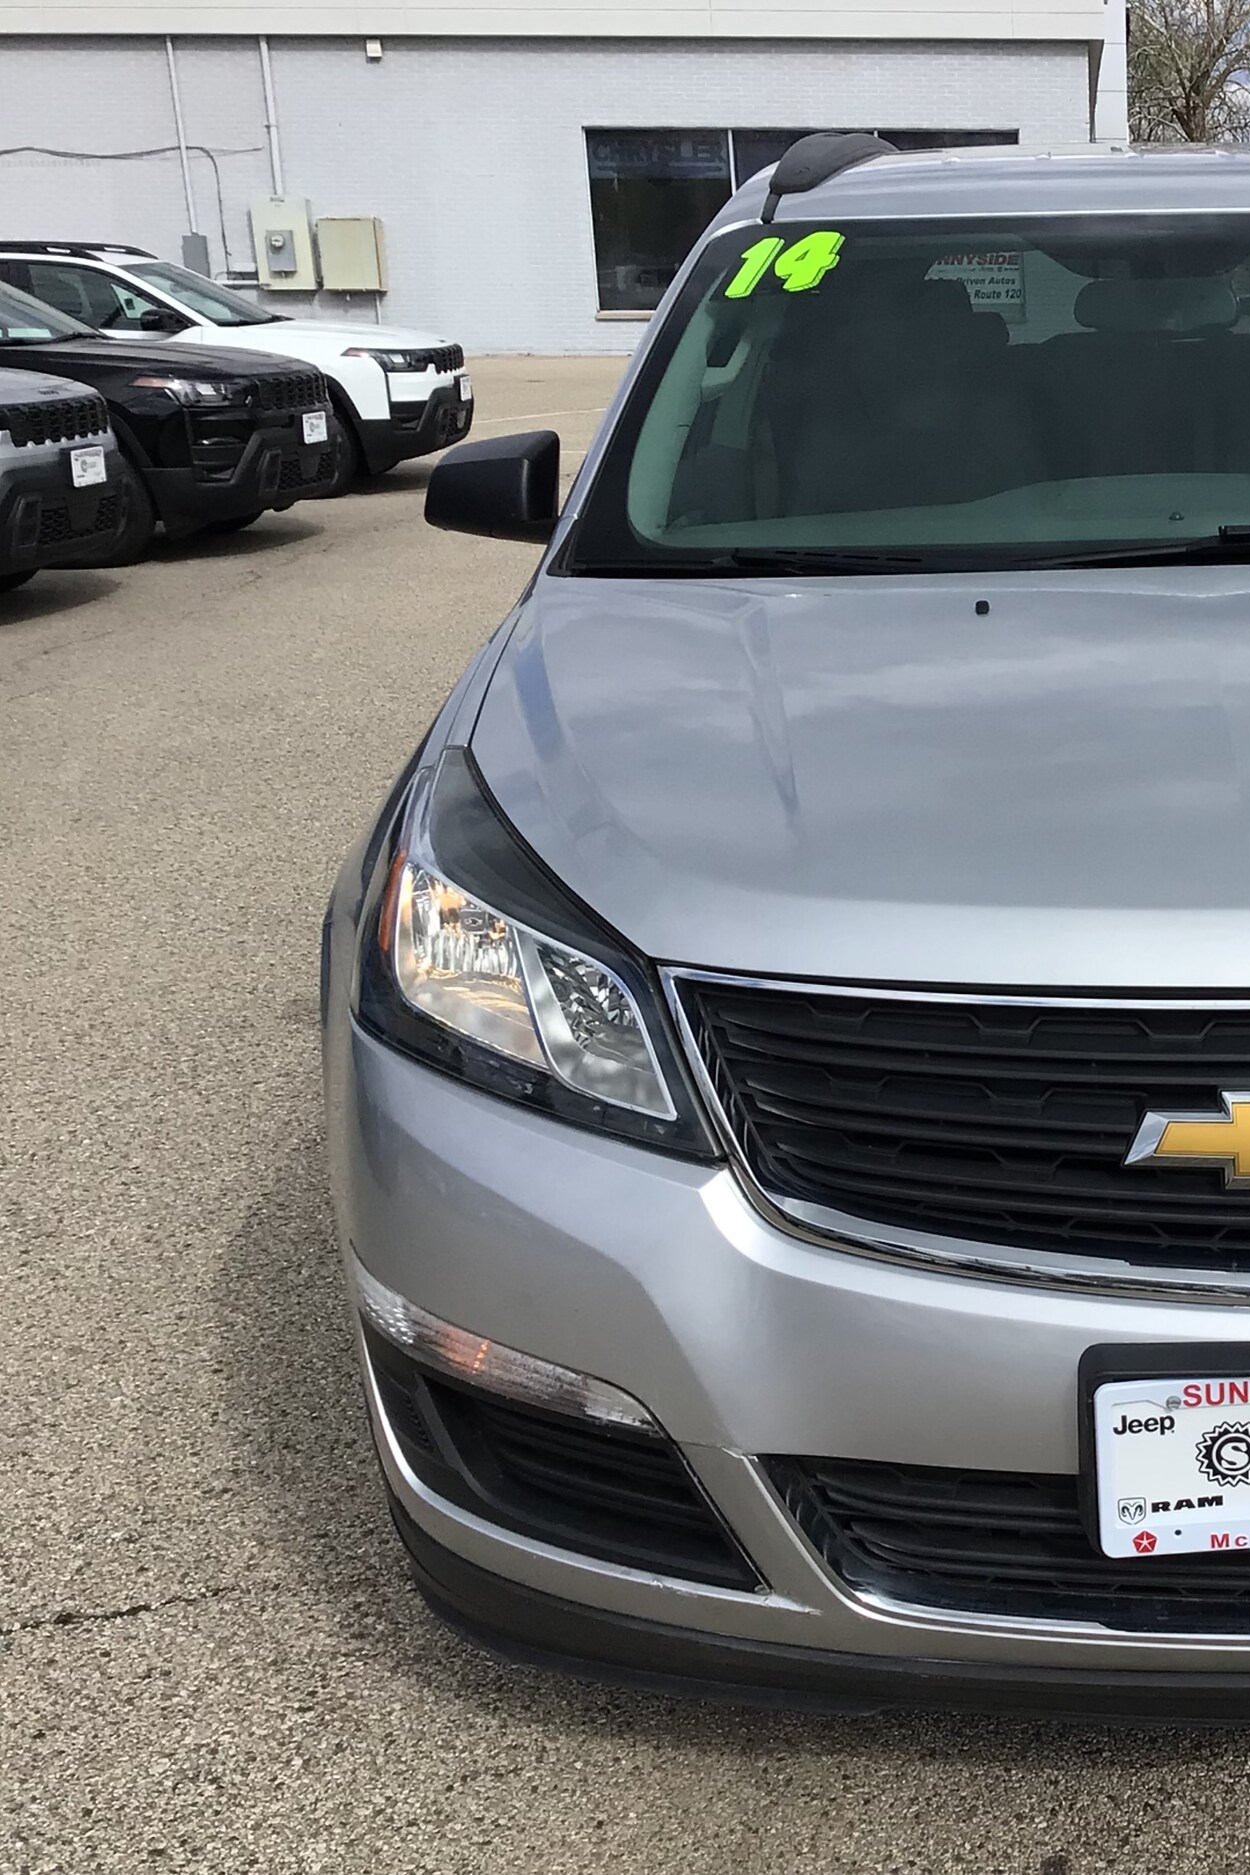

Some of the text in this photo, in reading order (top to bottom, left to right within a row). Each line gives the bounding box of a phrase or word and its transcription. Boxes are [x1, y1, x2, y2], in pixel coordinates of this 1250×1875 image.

[725, 231, 846, 298] 14
[988, 277, 1016, 285] Autos
[973, 288, 1022, 299] Route 120
[1113, 1415, 1175, 1435] Jeep
[1151, 1495, 1223, 1513] RAM
